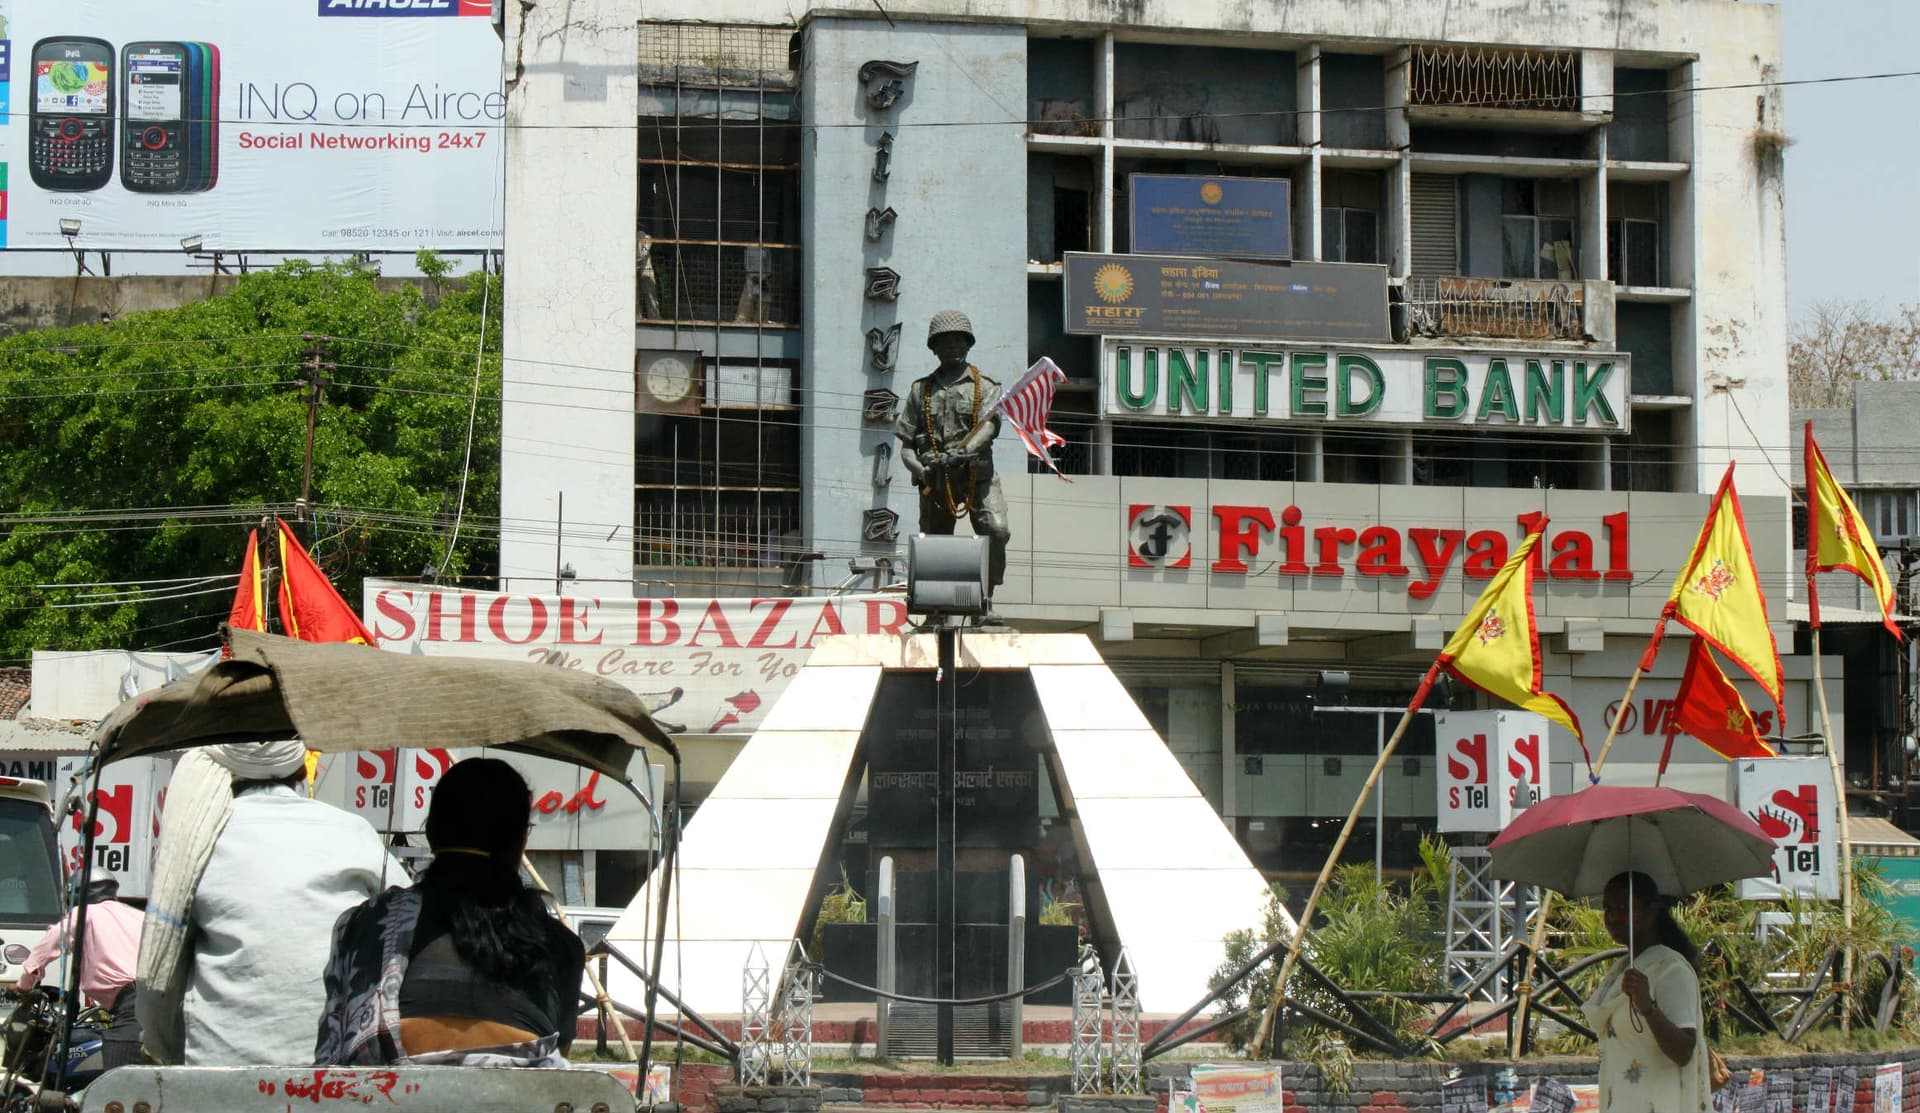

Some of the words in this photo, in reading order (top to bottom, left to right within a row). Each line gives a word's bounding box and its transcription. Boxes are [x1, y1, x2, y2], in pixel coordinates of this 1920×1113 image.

[238, 82, 318, 121] INQ
[334, 92, 385, 120] on
[401, 83, 506, 120] Airce
[238, 131, 302, 150] Social
[311, 132, 431, 153] Networking
[438, 132, 487, 149] 24x7
[340, 228, 369, 238] 98520
[372, 228, 400, 238] 12345
[401, 229, 411, 238] or
[1116, 345, 1387, 418] UNITED
[1423, 354, 1619, 426] BANK
[1211, 503, 1635, 601] Firayalal
[374, 588, 604, 645] SHOE
[630, 598, 908, 649] BAZAR
[596, 648, 676, 676] Care
[688, 651, 744, 677] For
[756, 652, 799, 683] Yo
[355, 786, 366, 808] S
[1449, 786, 1460, 809] S
[1465, 785, 1489, 808] Tel
[95, 845, 130, 872] Tel
[1784, 845, 1820, 873] Tel
